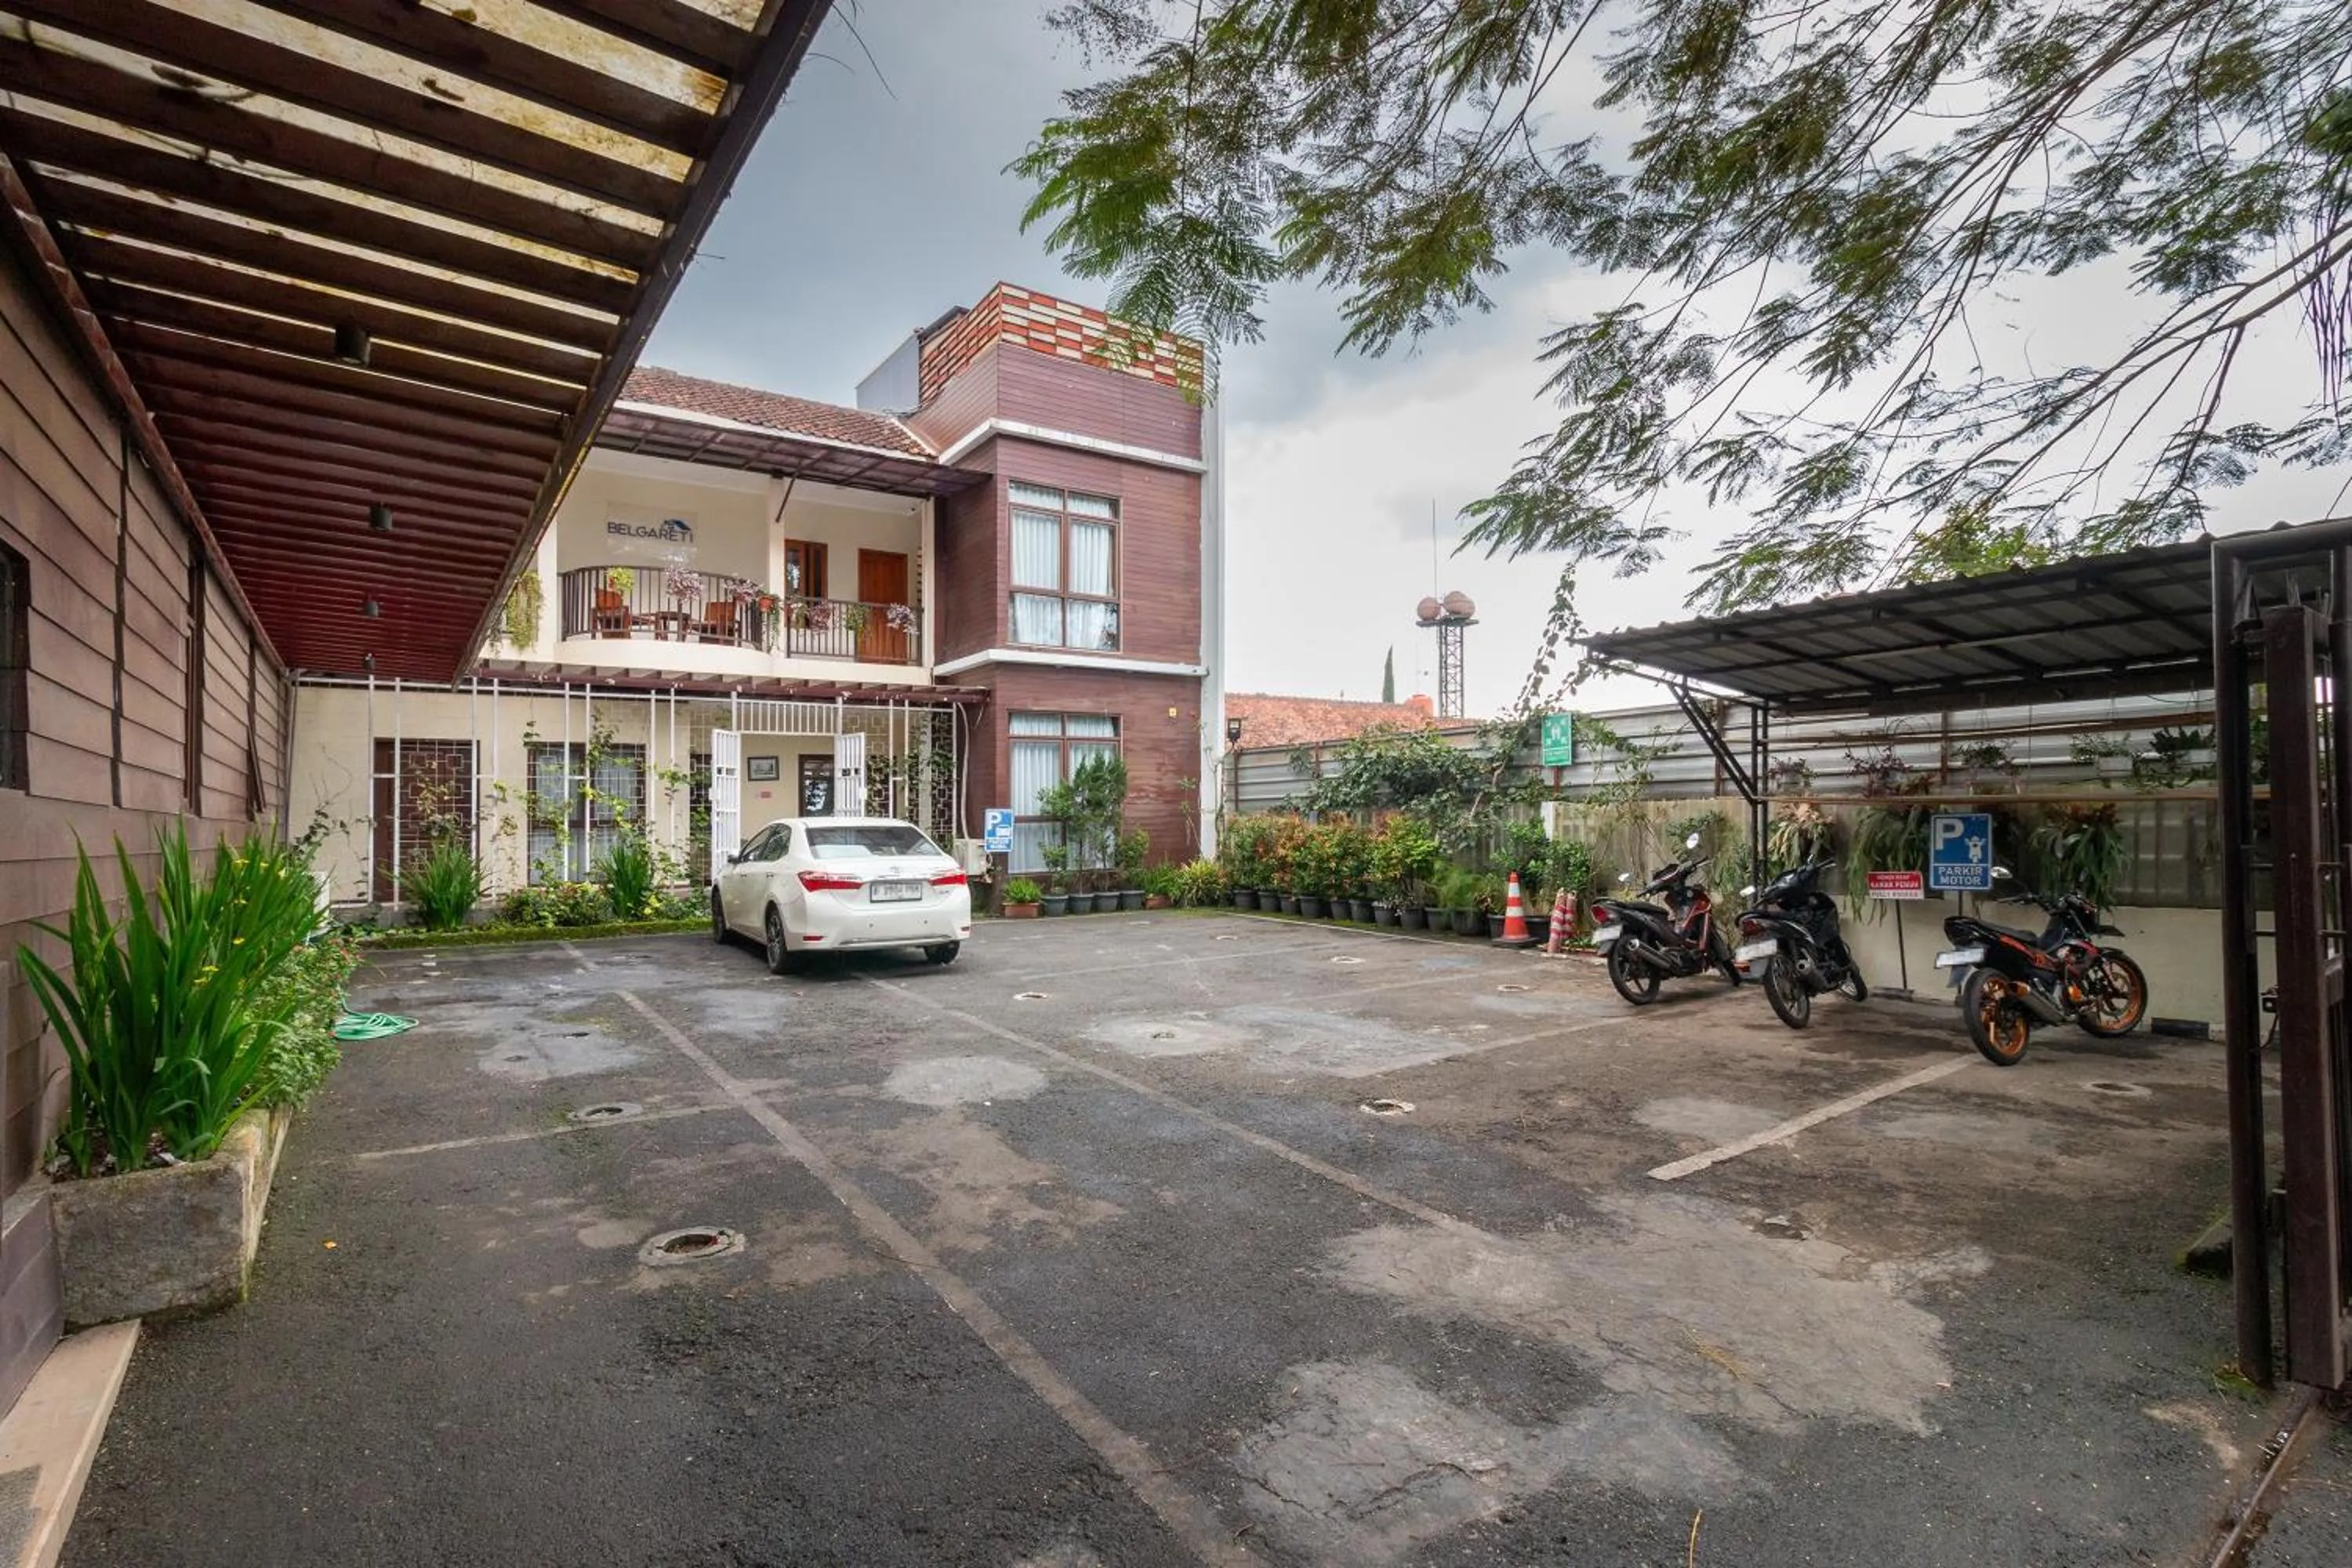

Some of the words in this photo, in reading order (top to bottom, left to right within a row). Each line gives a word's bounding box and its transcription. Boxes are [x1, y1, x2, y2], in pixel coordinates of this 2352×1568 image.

[608, 521, 693, 543] BELGARETI
[986, 811, 1002, 829] P
[1936, 818, 1964, 850] P
[1938, 866, 1983, 876] PARKIR
[1940, 876, 1981, 885] MOTOR
